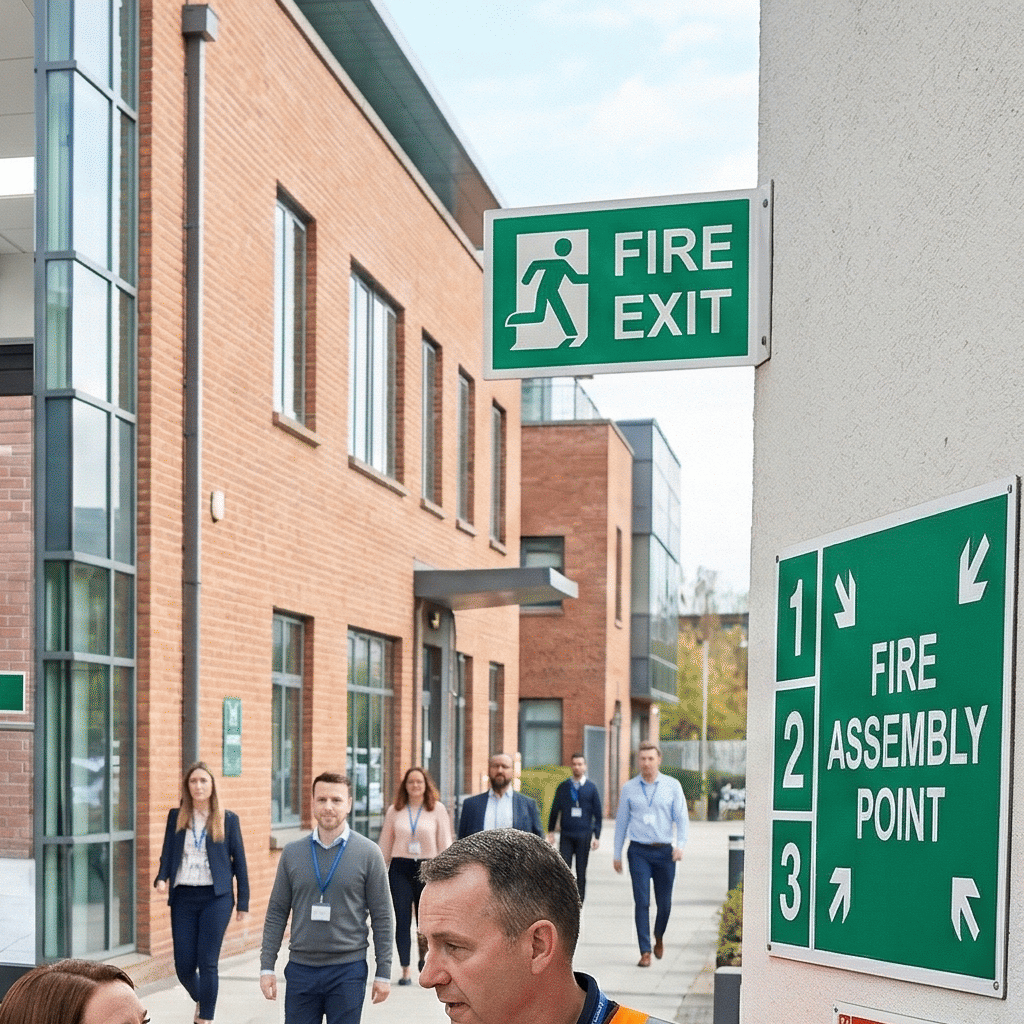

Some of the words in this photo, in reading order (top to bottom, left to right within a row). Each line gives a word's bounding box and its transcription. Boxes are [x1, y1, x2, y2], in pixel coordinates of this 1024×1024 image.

[614, 223, 733, 277] FIRE
[614, 288, 732, 340] EXIT
[789, 578, 803, 657] 1
[871, 633, 938, 697] FIRE
[782, 710, 805, 789] 2
[826, 704, 989, 770] ASSEMBLY
[856, 786, 946, 842] POINT
[779, 841, 802, 921] 3
